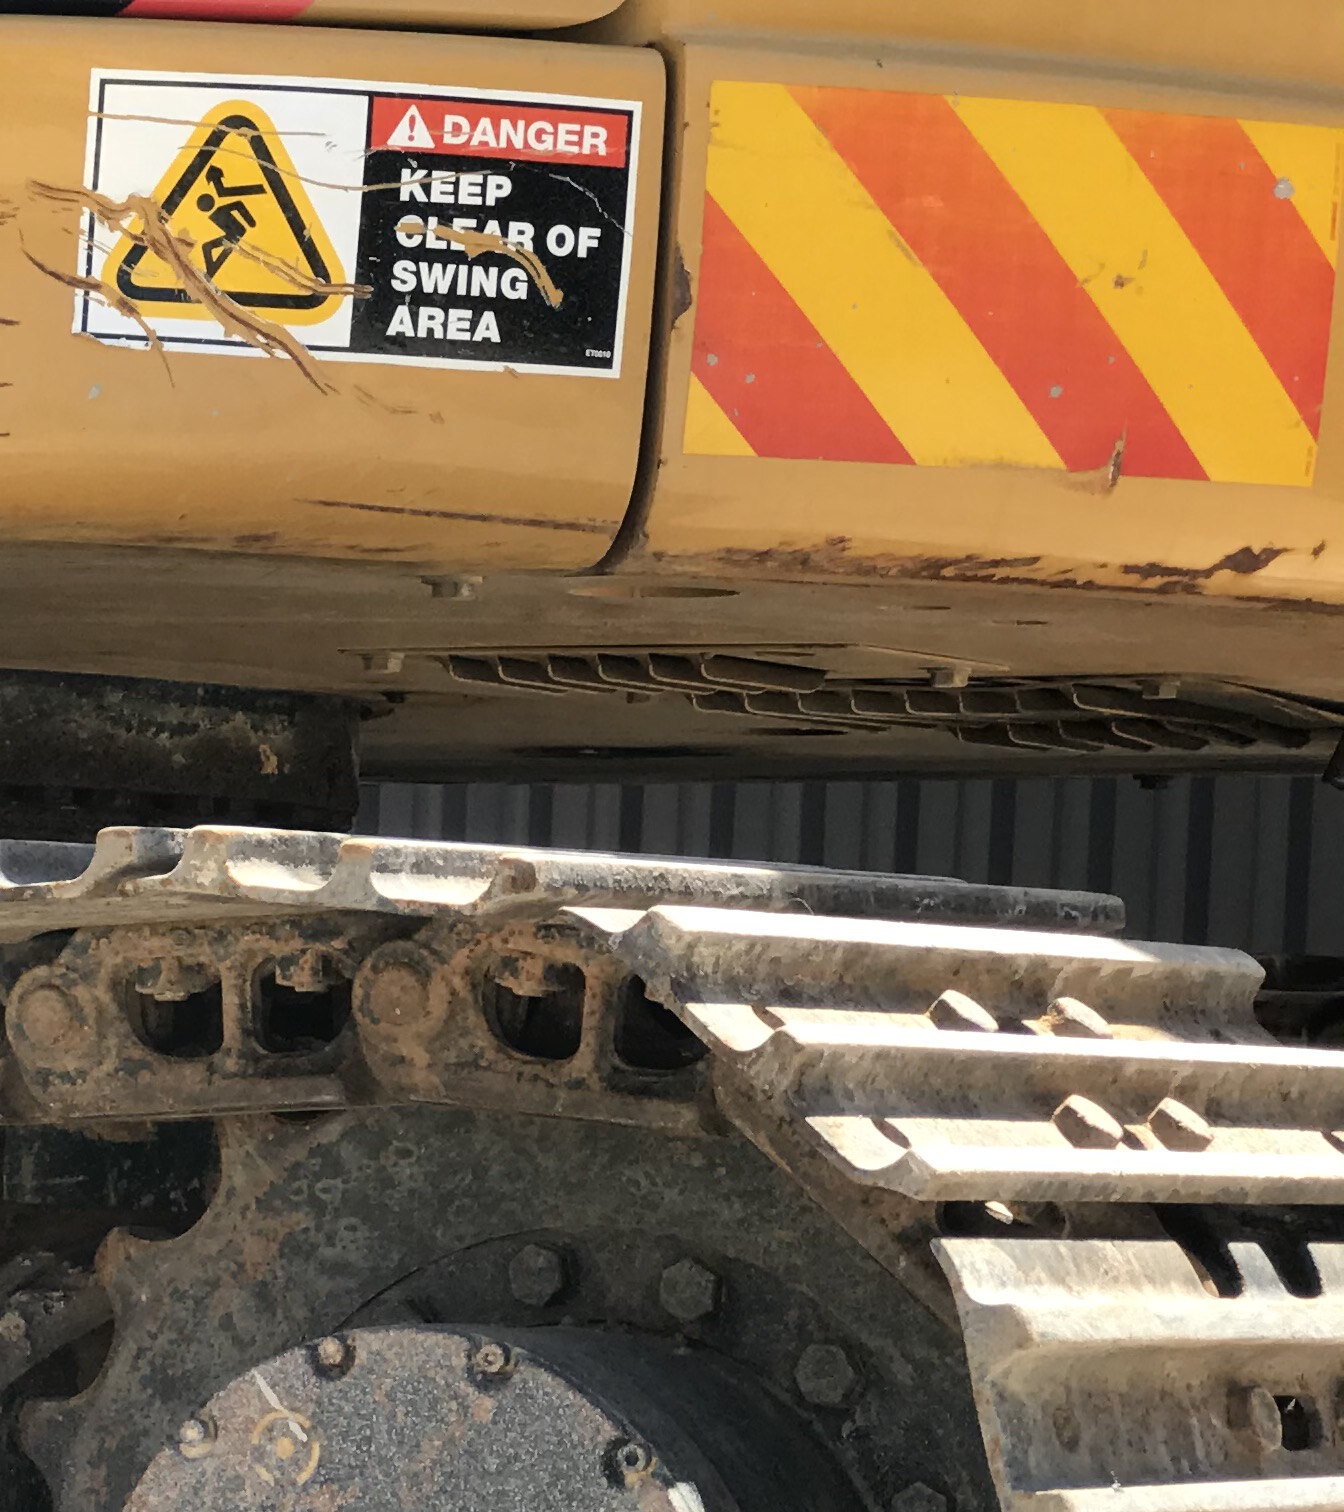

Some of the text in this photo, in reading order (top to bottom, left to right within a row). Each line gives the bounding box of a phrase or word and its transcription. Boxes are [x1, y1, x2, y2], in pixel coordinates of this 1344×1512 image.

[443, 114, 608, 155] DANGER
[400, 168, 512, 206] KEEP
[546, 224, 602, 258] OF
[391, 259, 528, 300] SWING
[385, 305, 501, 343] AREA
